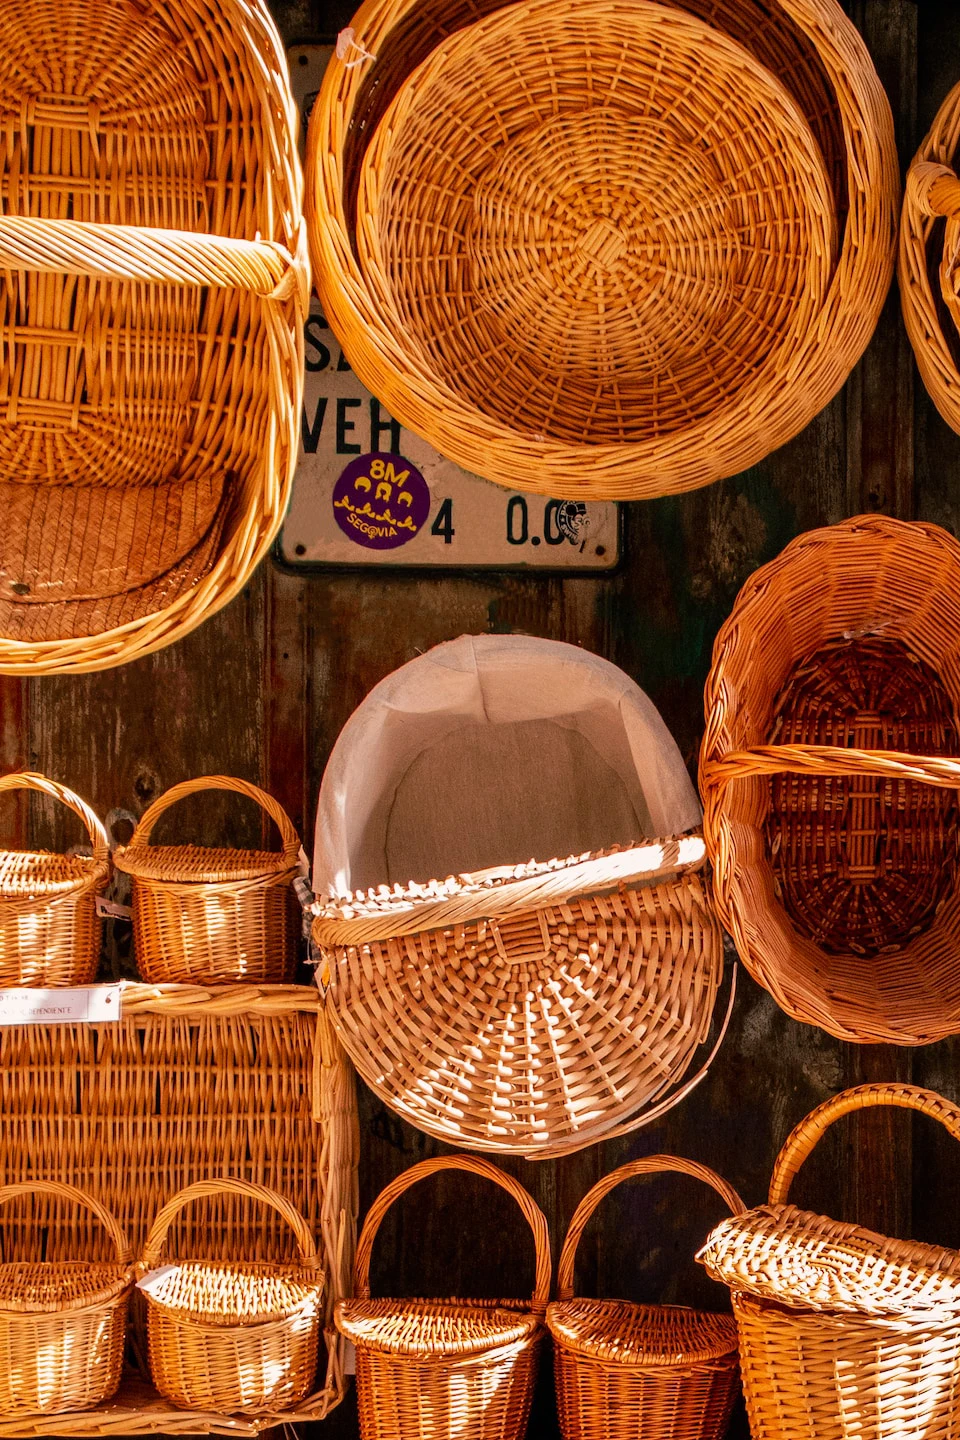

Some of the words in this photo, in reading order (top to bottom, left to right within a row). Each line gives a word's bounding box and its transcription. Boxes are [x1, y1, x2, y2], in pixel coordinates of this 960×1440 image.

[369, 459, 411, 488] 8M
[346, 512, 398, 539] SEGOVIA
[430, 498, 455, 544] 4
